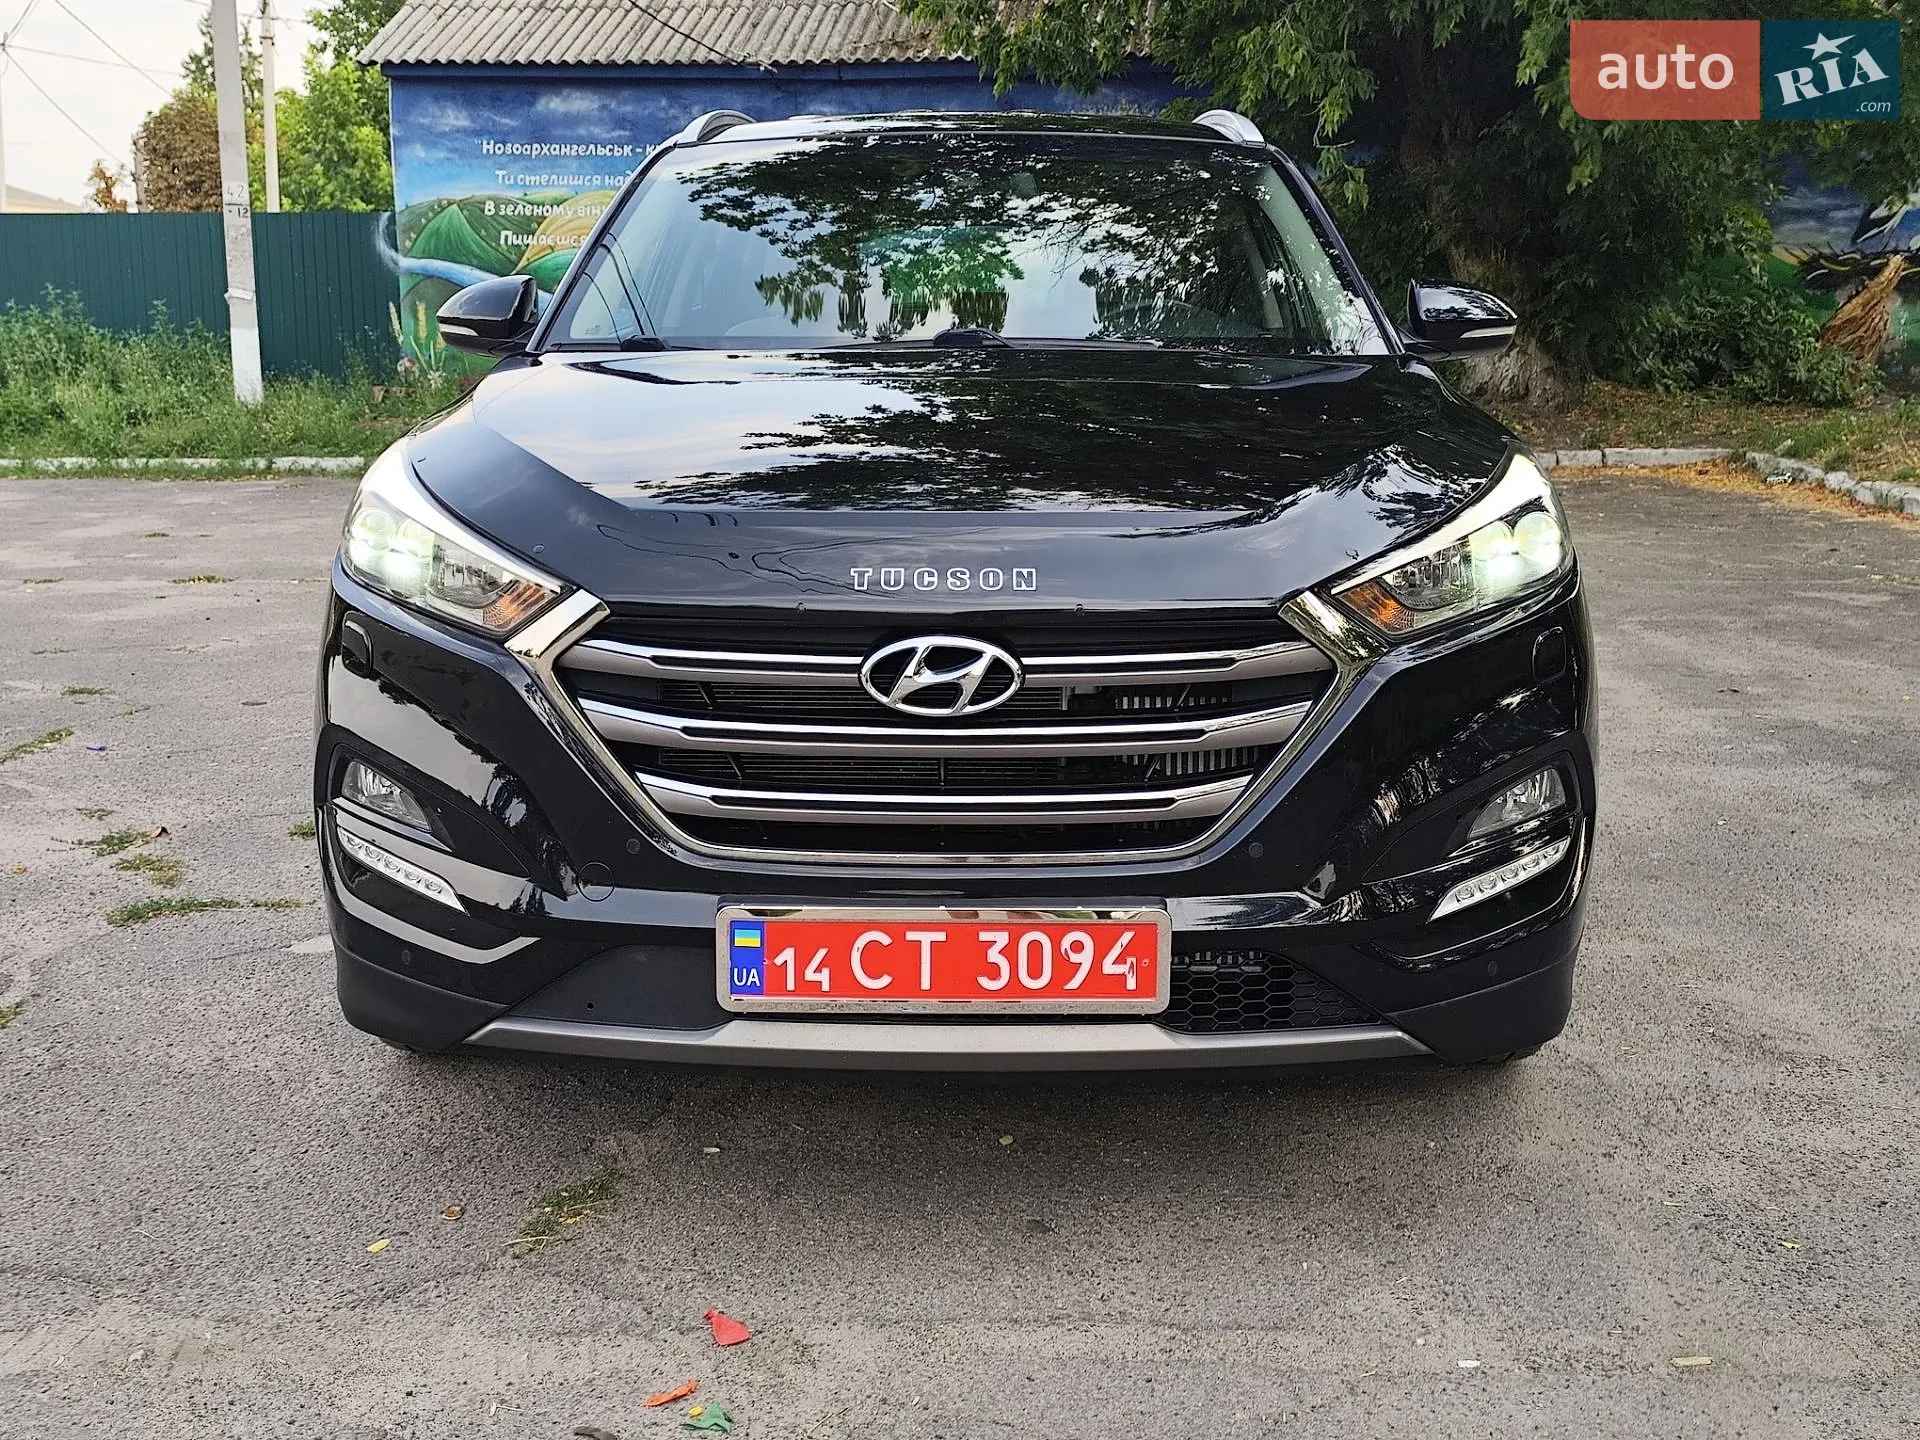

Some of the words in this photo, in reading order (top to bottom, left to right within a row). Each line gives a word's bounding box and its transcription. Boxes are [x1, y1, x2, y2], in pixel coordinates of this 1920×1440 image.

[496, 170, 514, 185] Ти
[517, 175, 600, 187] стелишся
[484, 201, 496, 216] В
[577, 204, 606, 217] він
[850, 567, 1037, 591] TUCSON
[773, 947, 830, 992] 14
[850, 930, 947, 991] CT
[976, 931, 1137, 991] 3094
[733, 967, 761, 987] UA
